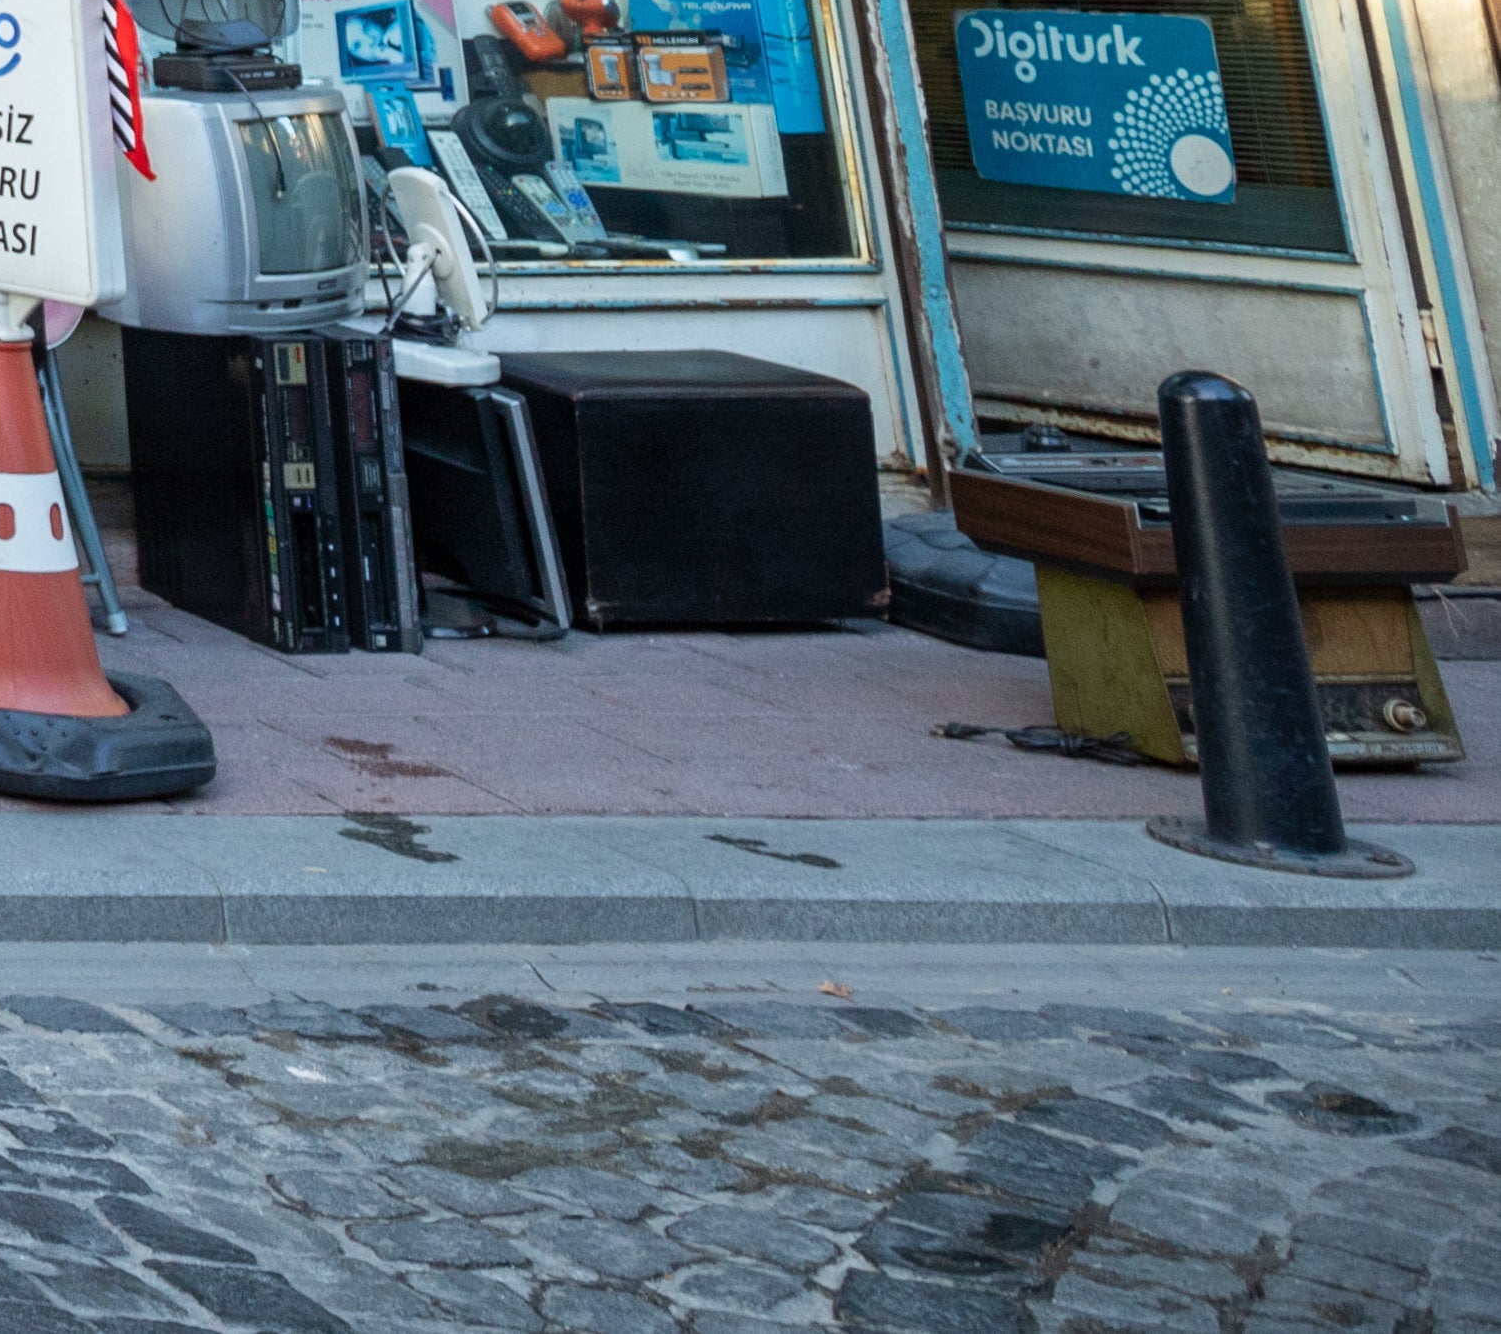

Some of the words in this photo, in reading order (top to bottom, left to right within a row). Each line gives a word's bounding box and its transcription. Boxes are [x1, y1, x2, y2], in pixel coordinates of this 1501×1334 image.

[969, 17, 1146, 83] Digiturk
[985, 99, 1092, 127] BAŞVURU
[991, 130, 1094, 159] NOKTASI
